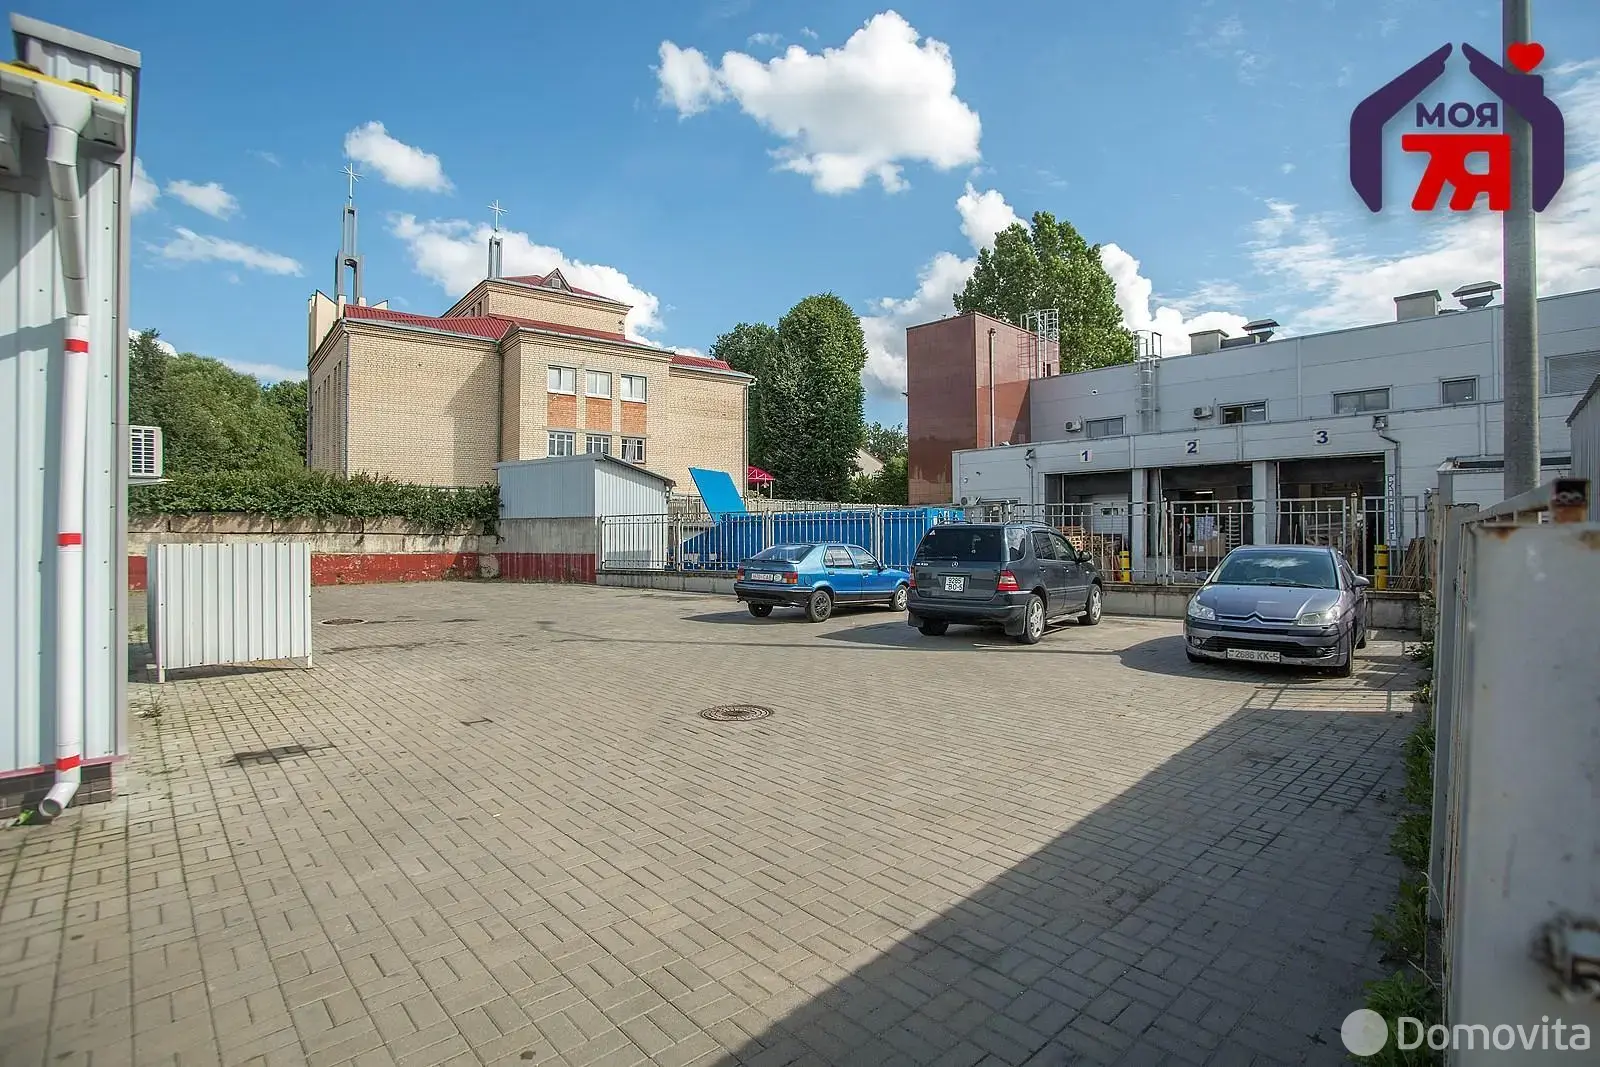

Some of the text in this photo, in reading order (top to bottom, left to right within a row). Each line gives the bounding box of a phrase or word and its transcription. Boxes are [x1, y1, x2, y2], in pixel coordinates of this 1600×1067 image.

[1316, 430, 1329, 444] 3
[1187, 442, 1198, 454] 2
[1081, 450, 1090, 462] 1
[1257, 651, 1280, 661] KK-5
